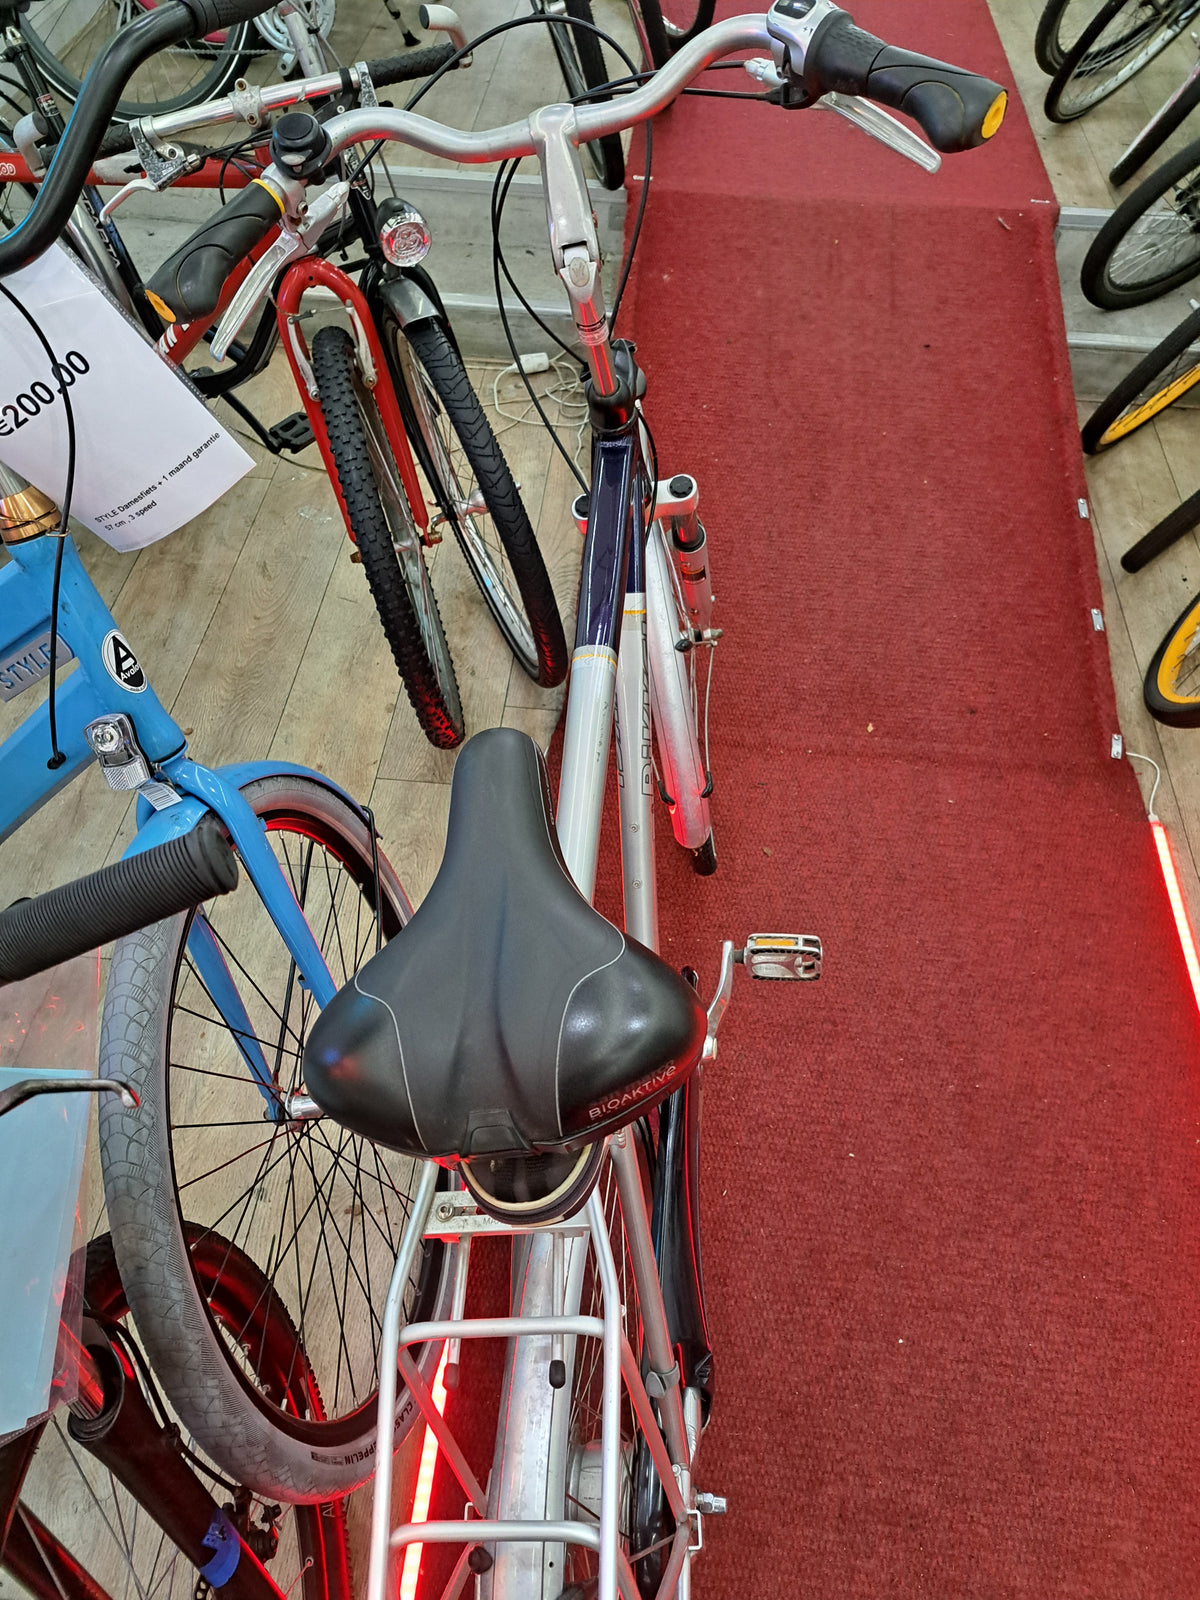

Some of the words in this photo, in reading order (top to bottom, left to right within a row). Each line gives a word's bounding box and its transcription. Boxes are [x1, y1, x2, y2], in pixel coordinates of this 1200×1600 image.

[94, 509, 119, 523] STYLE
[117, 484, 157, 512] Damesfiets
[168, 455, 193, 478] maand
[192, 432, 220, 459] garantie
[114, 520, 126, 528] cm
[135, 499, 157, 516] speed
